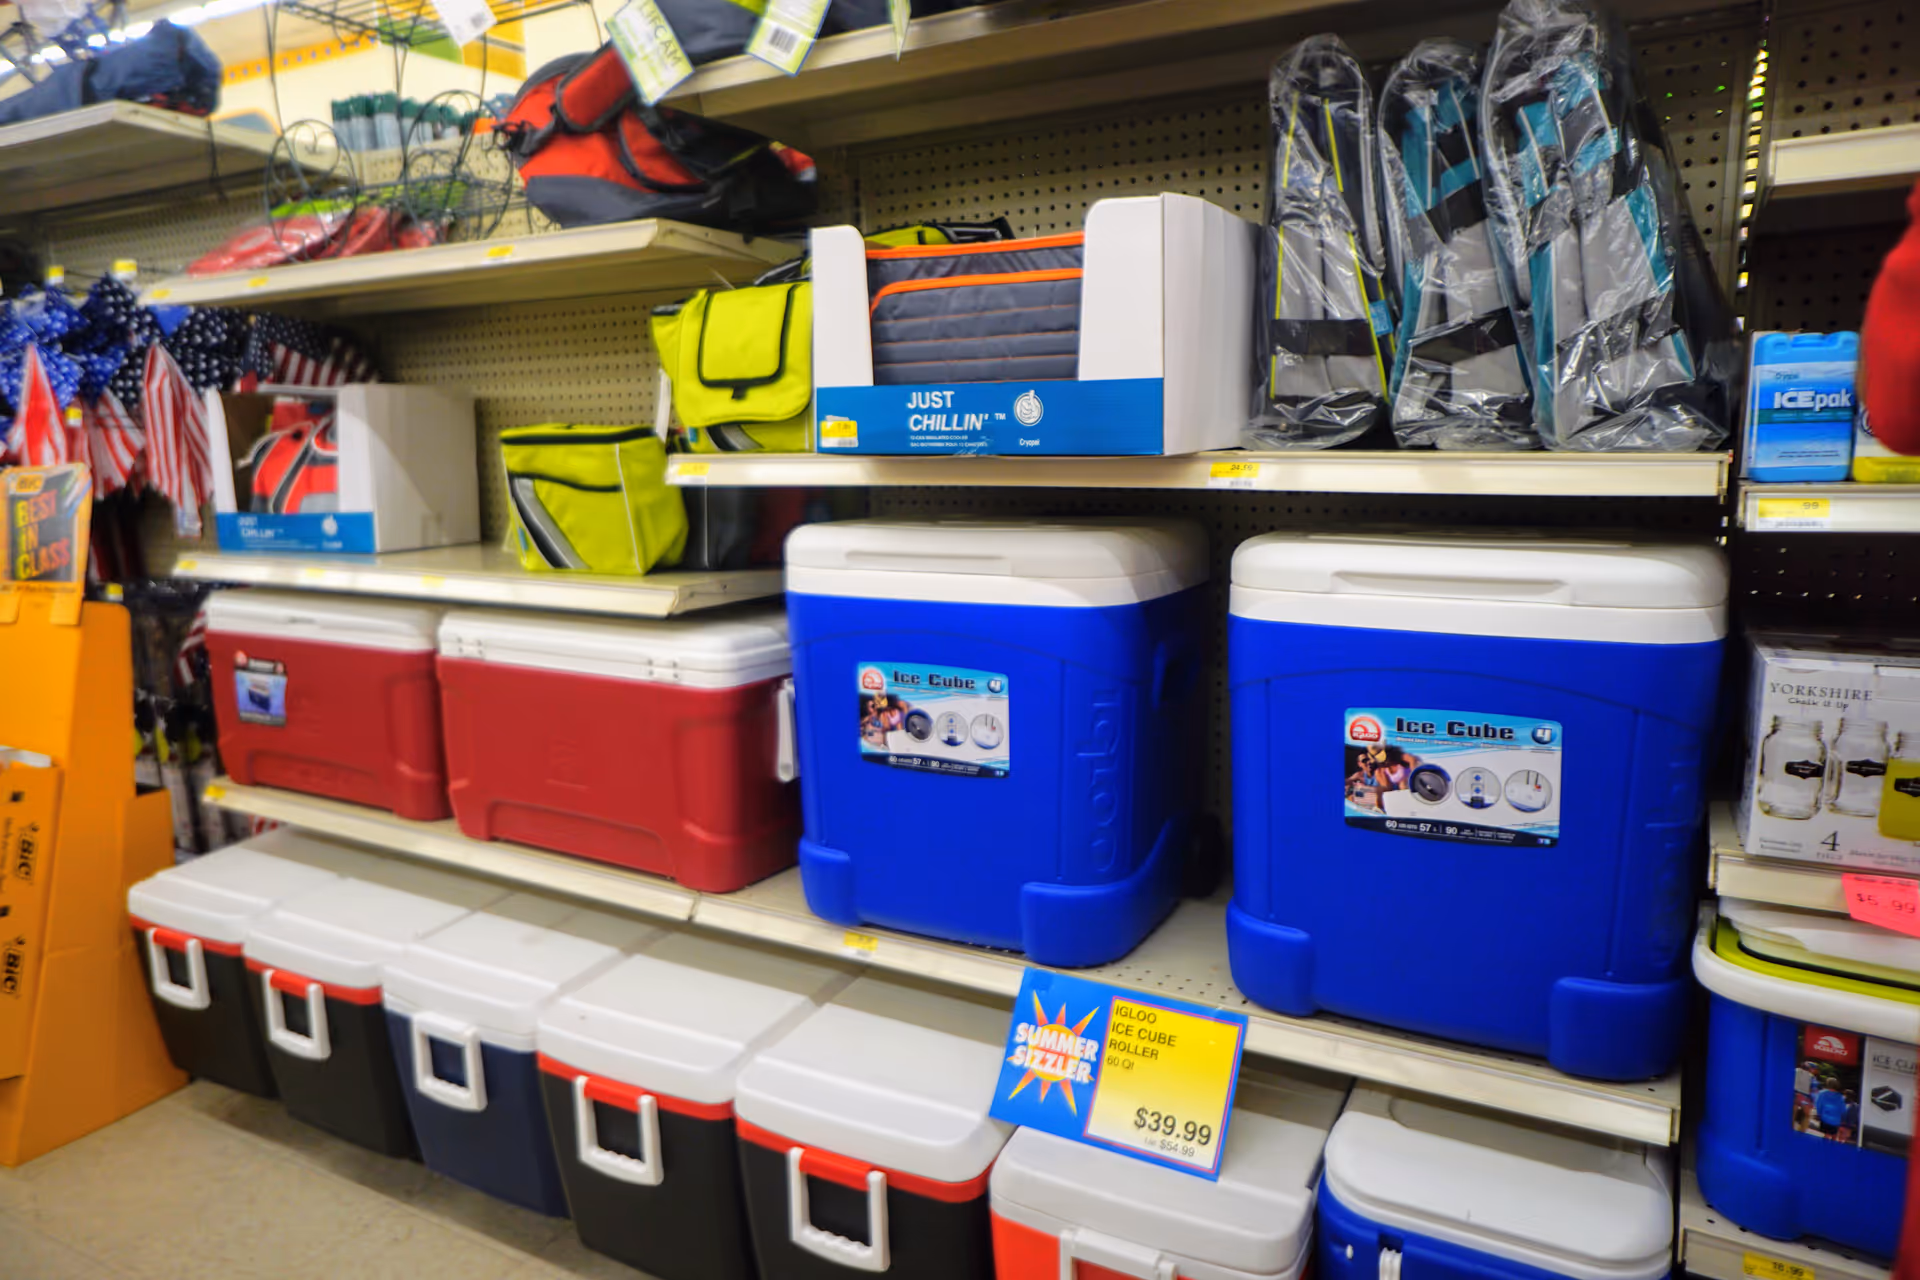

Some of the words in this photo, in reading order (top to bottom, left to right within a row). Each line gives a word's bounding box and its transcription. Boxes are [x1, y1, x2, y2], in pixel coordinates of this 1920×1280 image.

[907, 391, 955, 409] JUST
[1773, 389, 1853, 412] ICEpak
[909, 413, 989, 431] CHILLIN'
[16, 537, 71, 579] CLASS
[893, 670, 921, 685] Ice
[928, 673, 976, 690] Cube
[1769, 682, 1873, 701] YORKSHIRE
[1396, 717, 1436, 735] Ice
[1446, 720, 1515, 740] Cube
[1536, 728, 1552, 742] 4
[912, 758, 922, 766] 57
[1385, 820, 1398, 829] 60
[1419, 822, 1432, 832] 57
[1445, 826, 1458, 835] 90
[1819, 830, 1840, 851] 4
[1856, 893, 1916, 914] $5.99
[1115, 1004, 1157, 1024] IGLOO
[1014, 1022, 1100, 1062] SUMMER
[1111, 1021, 1135, 1037] ICE
[1137, 1027, 1177, 1048] CUBE
[1108, 1038, 1160, 1061] ROLLER
[1872, 1054, 1891, 1064] ICE
[1013, 1045, 1092, 1084] SIZZLER
[1106, 1054, 1120, 1067] 60
[1134, 1107, 1213, 1146] $39.99
[1159, 1139, 1196, 1158] $54.99
